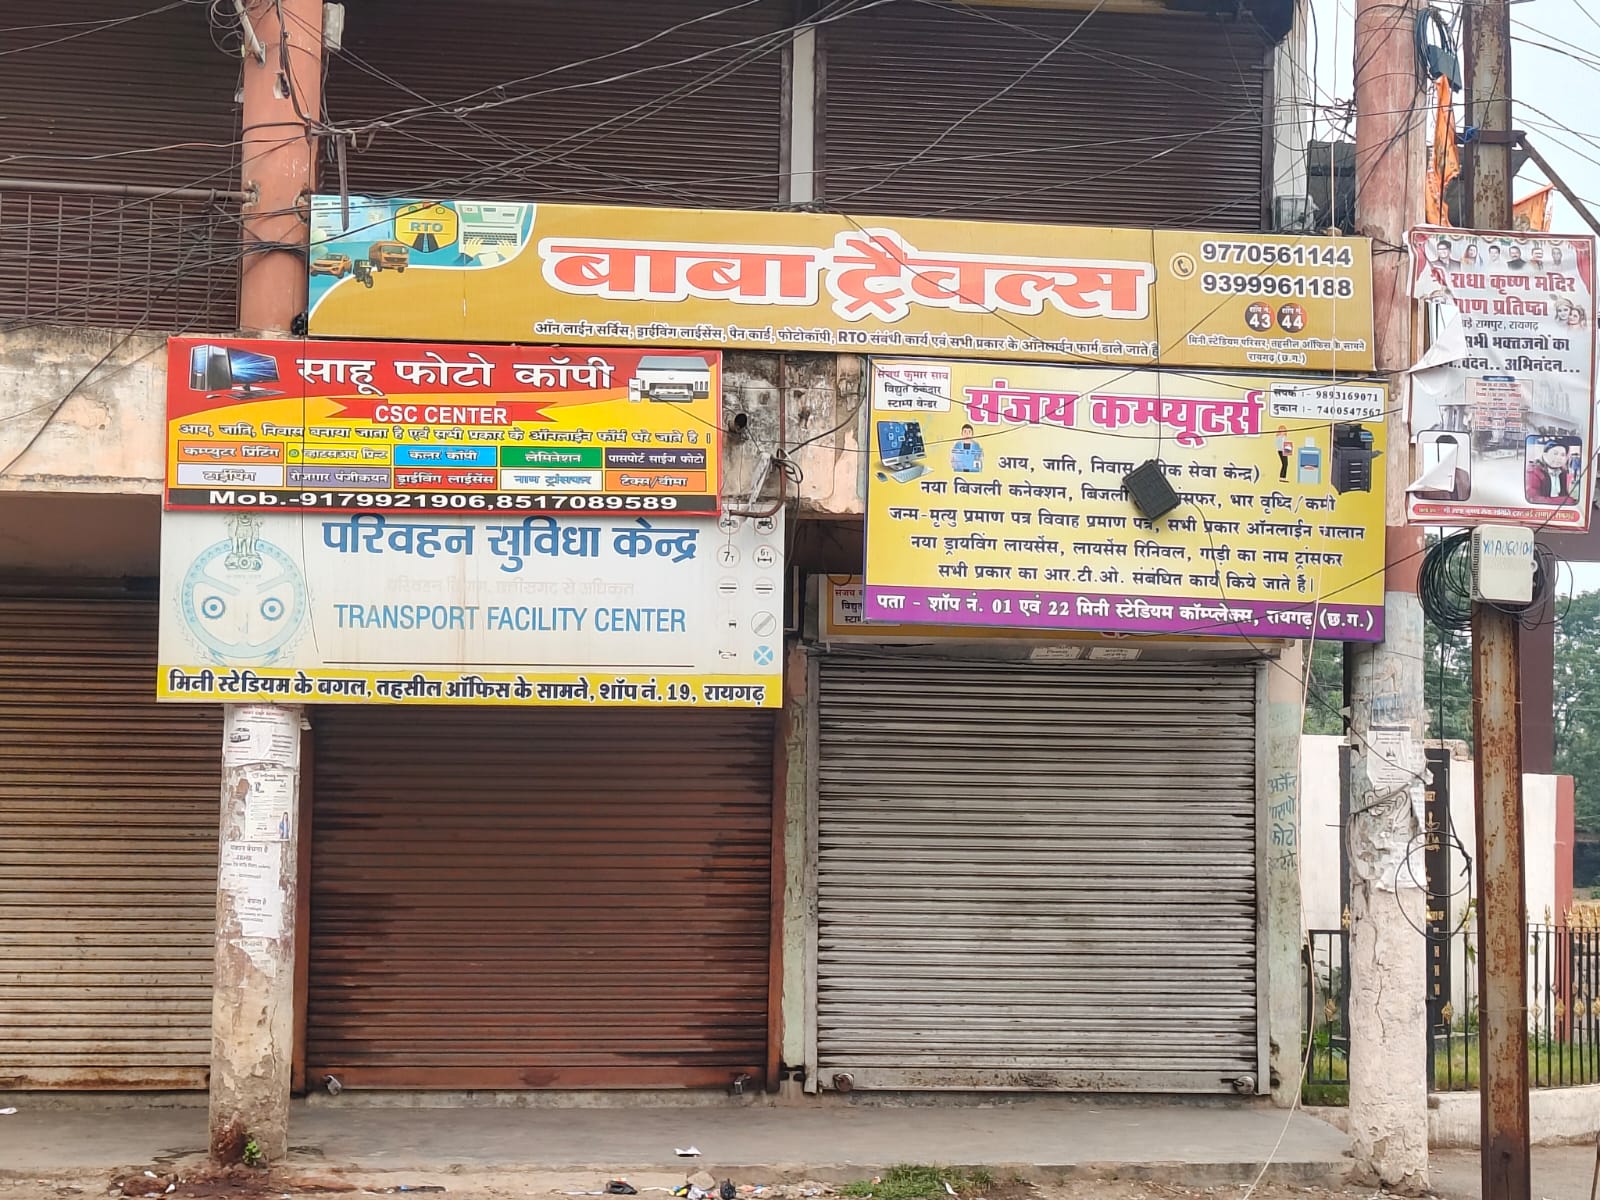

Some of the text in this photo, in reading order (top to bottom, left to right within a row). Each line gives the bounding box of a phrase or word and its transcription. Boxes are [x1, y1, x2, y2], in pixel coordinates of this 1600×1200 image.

[410, 222, 444, 233] RTO
[1202, 240, 1352, 268] 9770561144
[550, 235, 1146, 314] बाबा ट्रैवल्स
[1203, 273, 1354, 298] 9399961188
[1450, 273, 1486, 289] राधा
[1489, 273, 1530, 294] कृष्ण
[1492, 295, 1549, 317] प्रतिष्ठा
[1249, 314, 1272, 328] 43
[1281, 316, 1304, 330] 44
[534, 321, 561, 335] ऑन
[563, 321, 594, 336] लाईन
[596, 322, 633, 338] सर्विस,
[729, 326, 745, 341] पैन
[778, 328, 836, 344] फोटोकॉपी,
[838, 332, 867, 344] RTO
[949, 335, 973, 348] सभी
[976, 338, 1005, 350] प्रकार
[1101, 341, 1124, 356] डाले
[1125, 341, 1149, 356] जाते
[1188, 335, 1206, 345] मिनी
[1492, 333, 1570, 351] भक्तजनों का
[295, 352, 616, 397] साहू फोटो कॉपी
[1315, 390, 1379, 402] 9893169071
[374, 405, 508, 426] CSC CENTER
[965, 379, 1265, 447] संजय कम्प्यूटर्स
[1272, 403, 1381, 417] दुकान 7400547567
[178, 424, 215, 437] आय,
[219, 422, 257, 438] जाति,
[261, 422, 305, 437] निवास
[308, 427, 353, 439] बनाया
[355, 428, 388, 440] जाता
[392, 426, 404, 440] है
[433, 427, 464, 441] सभी
[468, 429, 504, 442] प्रकार
[508, 427, 525, 441] के
[530, 428, 592, 444] ऑनलाईन
[655, 430, 683, 444] जाते
[408, 448, 478, 461] कलर कॉपी
[524, 450, 583, 463] लेमिनेशन
[608, 452, 705, 465] पासपोर्ट साईज फोटो
[289, 470, 331, 482] रोजगार
[998, 456, 1035, 473] आय,
[1043, 455, 1083, 475] जाति,
[1188, 461, 1218, 478] सेवा
[921, 481, 947, 494] नया
[954, 477, 1001, 496] बिजली
[1008, 482, 1073, 501] कनेक्शन,
[1230, 494, 1254, 508] भार
[964, 509, 1005, 525] प्रमाण
[1011, 510, 1032, 525] पत्र
[1038, 508, 1080, 527] विवाह
[1087, 514, 1127, 529] प्रमाण
[1168, 516, 1197, 532] सभी
[1203, 520, 1240, 534] प्रकार
[1247, 519, 1313, 538] ऑनलाईन
[1319, 525, 1365, 539] चालान
[321, 513, 700, 573] परिवहन सुविधा केन्द्र
[911, 533, 1343, 569] नया ड्रायविंग लायसेंस, लायसेंस रिनिवल, गाड़ी का नाम ट्रांसफर
[938, 561, 968, 578] सभी
[975, 565, 1012, 580] प्रकार
[1018, 566, 1038, 579] का
[1132, 566, 1183, 587] संबंधित
[1189, 569, 1220, 588] कार्य
[1226, 570, 1256, 589] किये
[1262, 573, 1291, 591] जाते
[333, 604, 686, 633] TRANSPORT FACILITY CENTER
[877, 594, 906, 609] पता
[927, 592, 961, 612] शॉप
[966, 592, 983, 613] नं.
[992, 599, 1012, 614] 01
[1018, 594, 1041, 617] एवं
[1048, 600, 1070, 616] 22
[1076, 596, 1110, 617] मिनी
[1115, 598, 1174, 620] स्टेडियम
[1266, 609, 1314, 630] रायगढ़
[1319, 608, 1374, 631] (छ.ग.)
[169, 668, 765, 706] मिनी स्टेडियम के बगल, तहसील ऑफिस के सामने, शॉप नं. 19, रायगढ़
